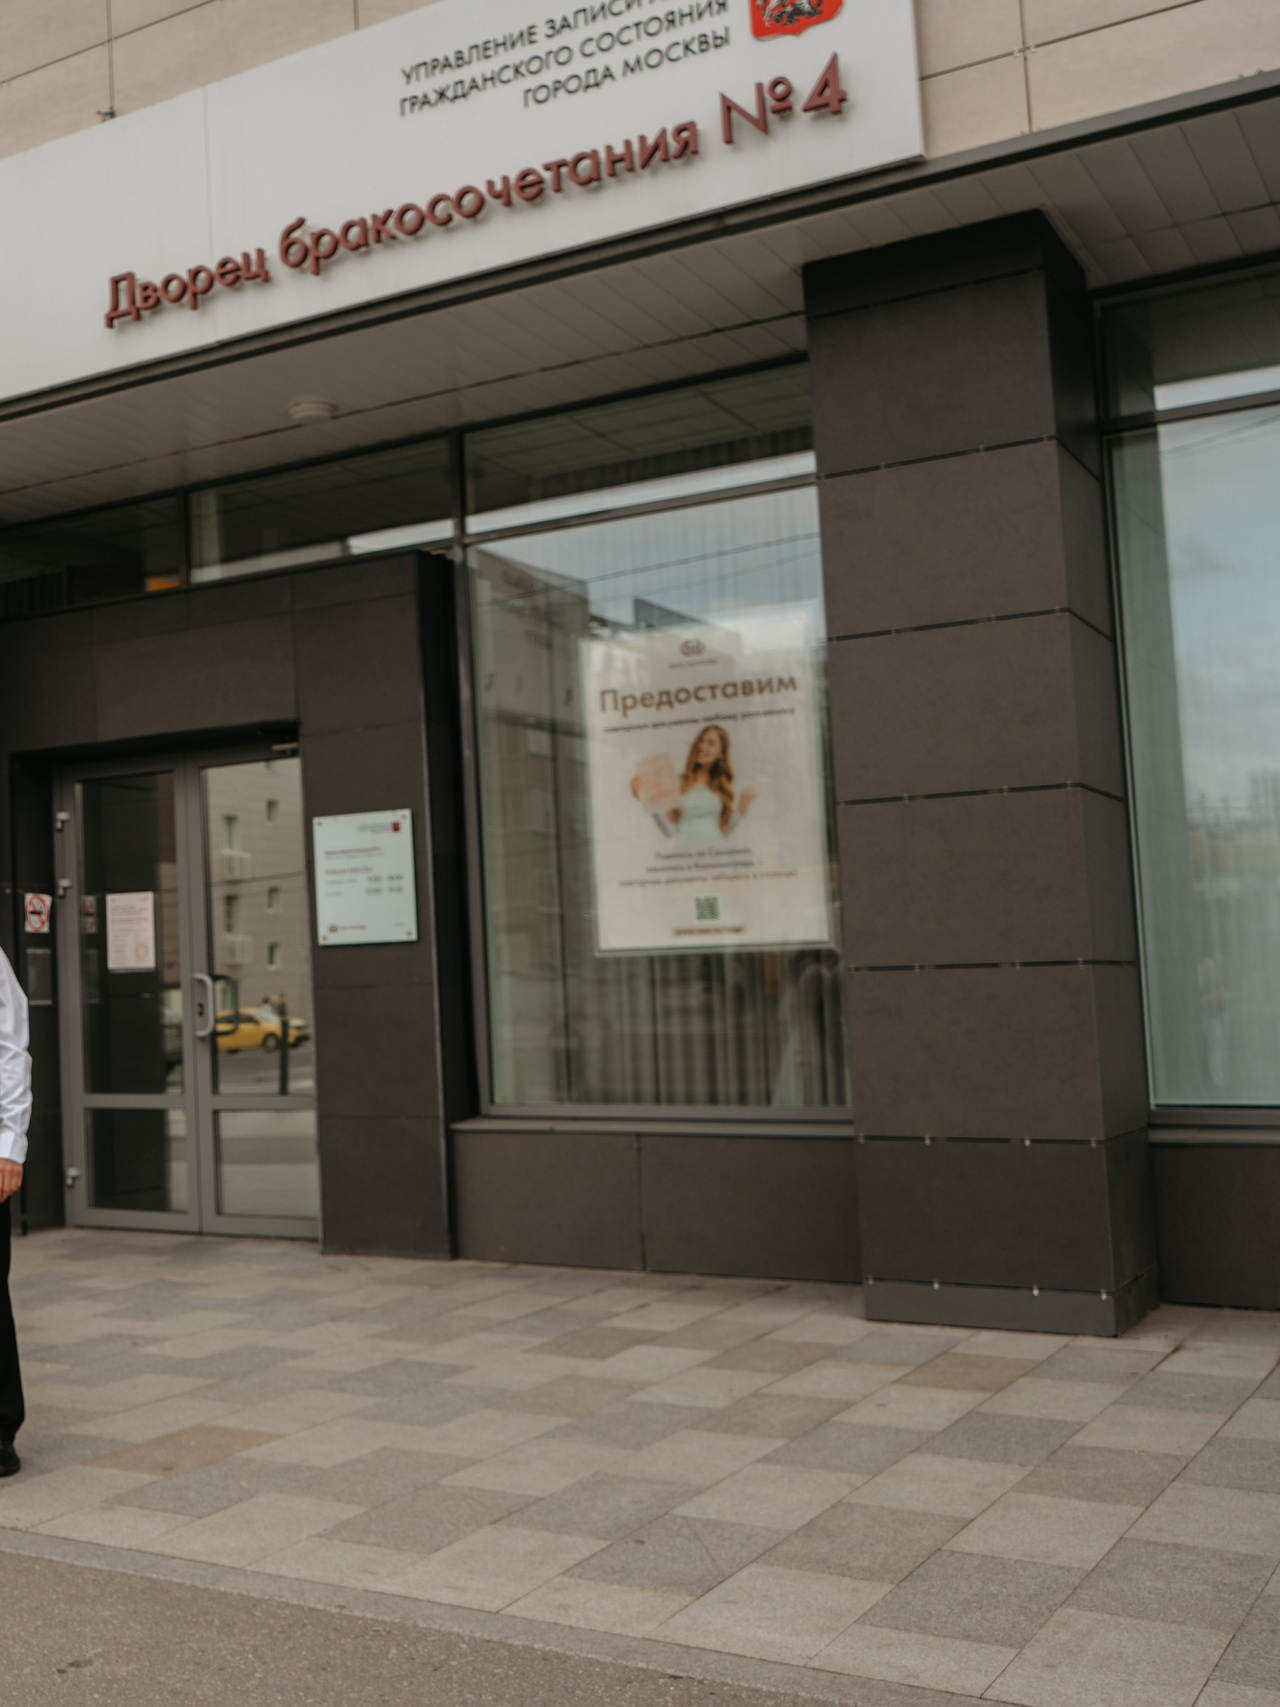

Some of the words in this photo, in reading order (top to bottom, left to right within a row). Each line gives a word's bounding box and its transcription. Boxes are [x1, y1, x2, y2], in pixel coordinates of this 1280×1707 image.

[399, 45, 572, 116] ГРАЖДАНСКОГО
[579, 0, 729, 58] СОСТОЯНИЯ
[401, 25, 537, 86] УПРАВЛЕНИЕ
[523, 67, 616, 108] ГОРОДА
[622, 26, 730, 77] МОСКВЫ
[105, 248, 271, 328] Дворец
[279, 120, 699, 276] бракосочетания
[600, 675, 798, 718] Предоставим
